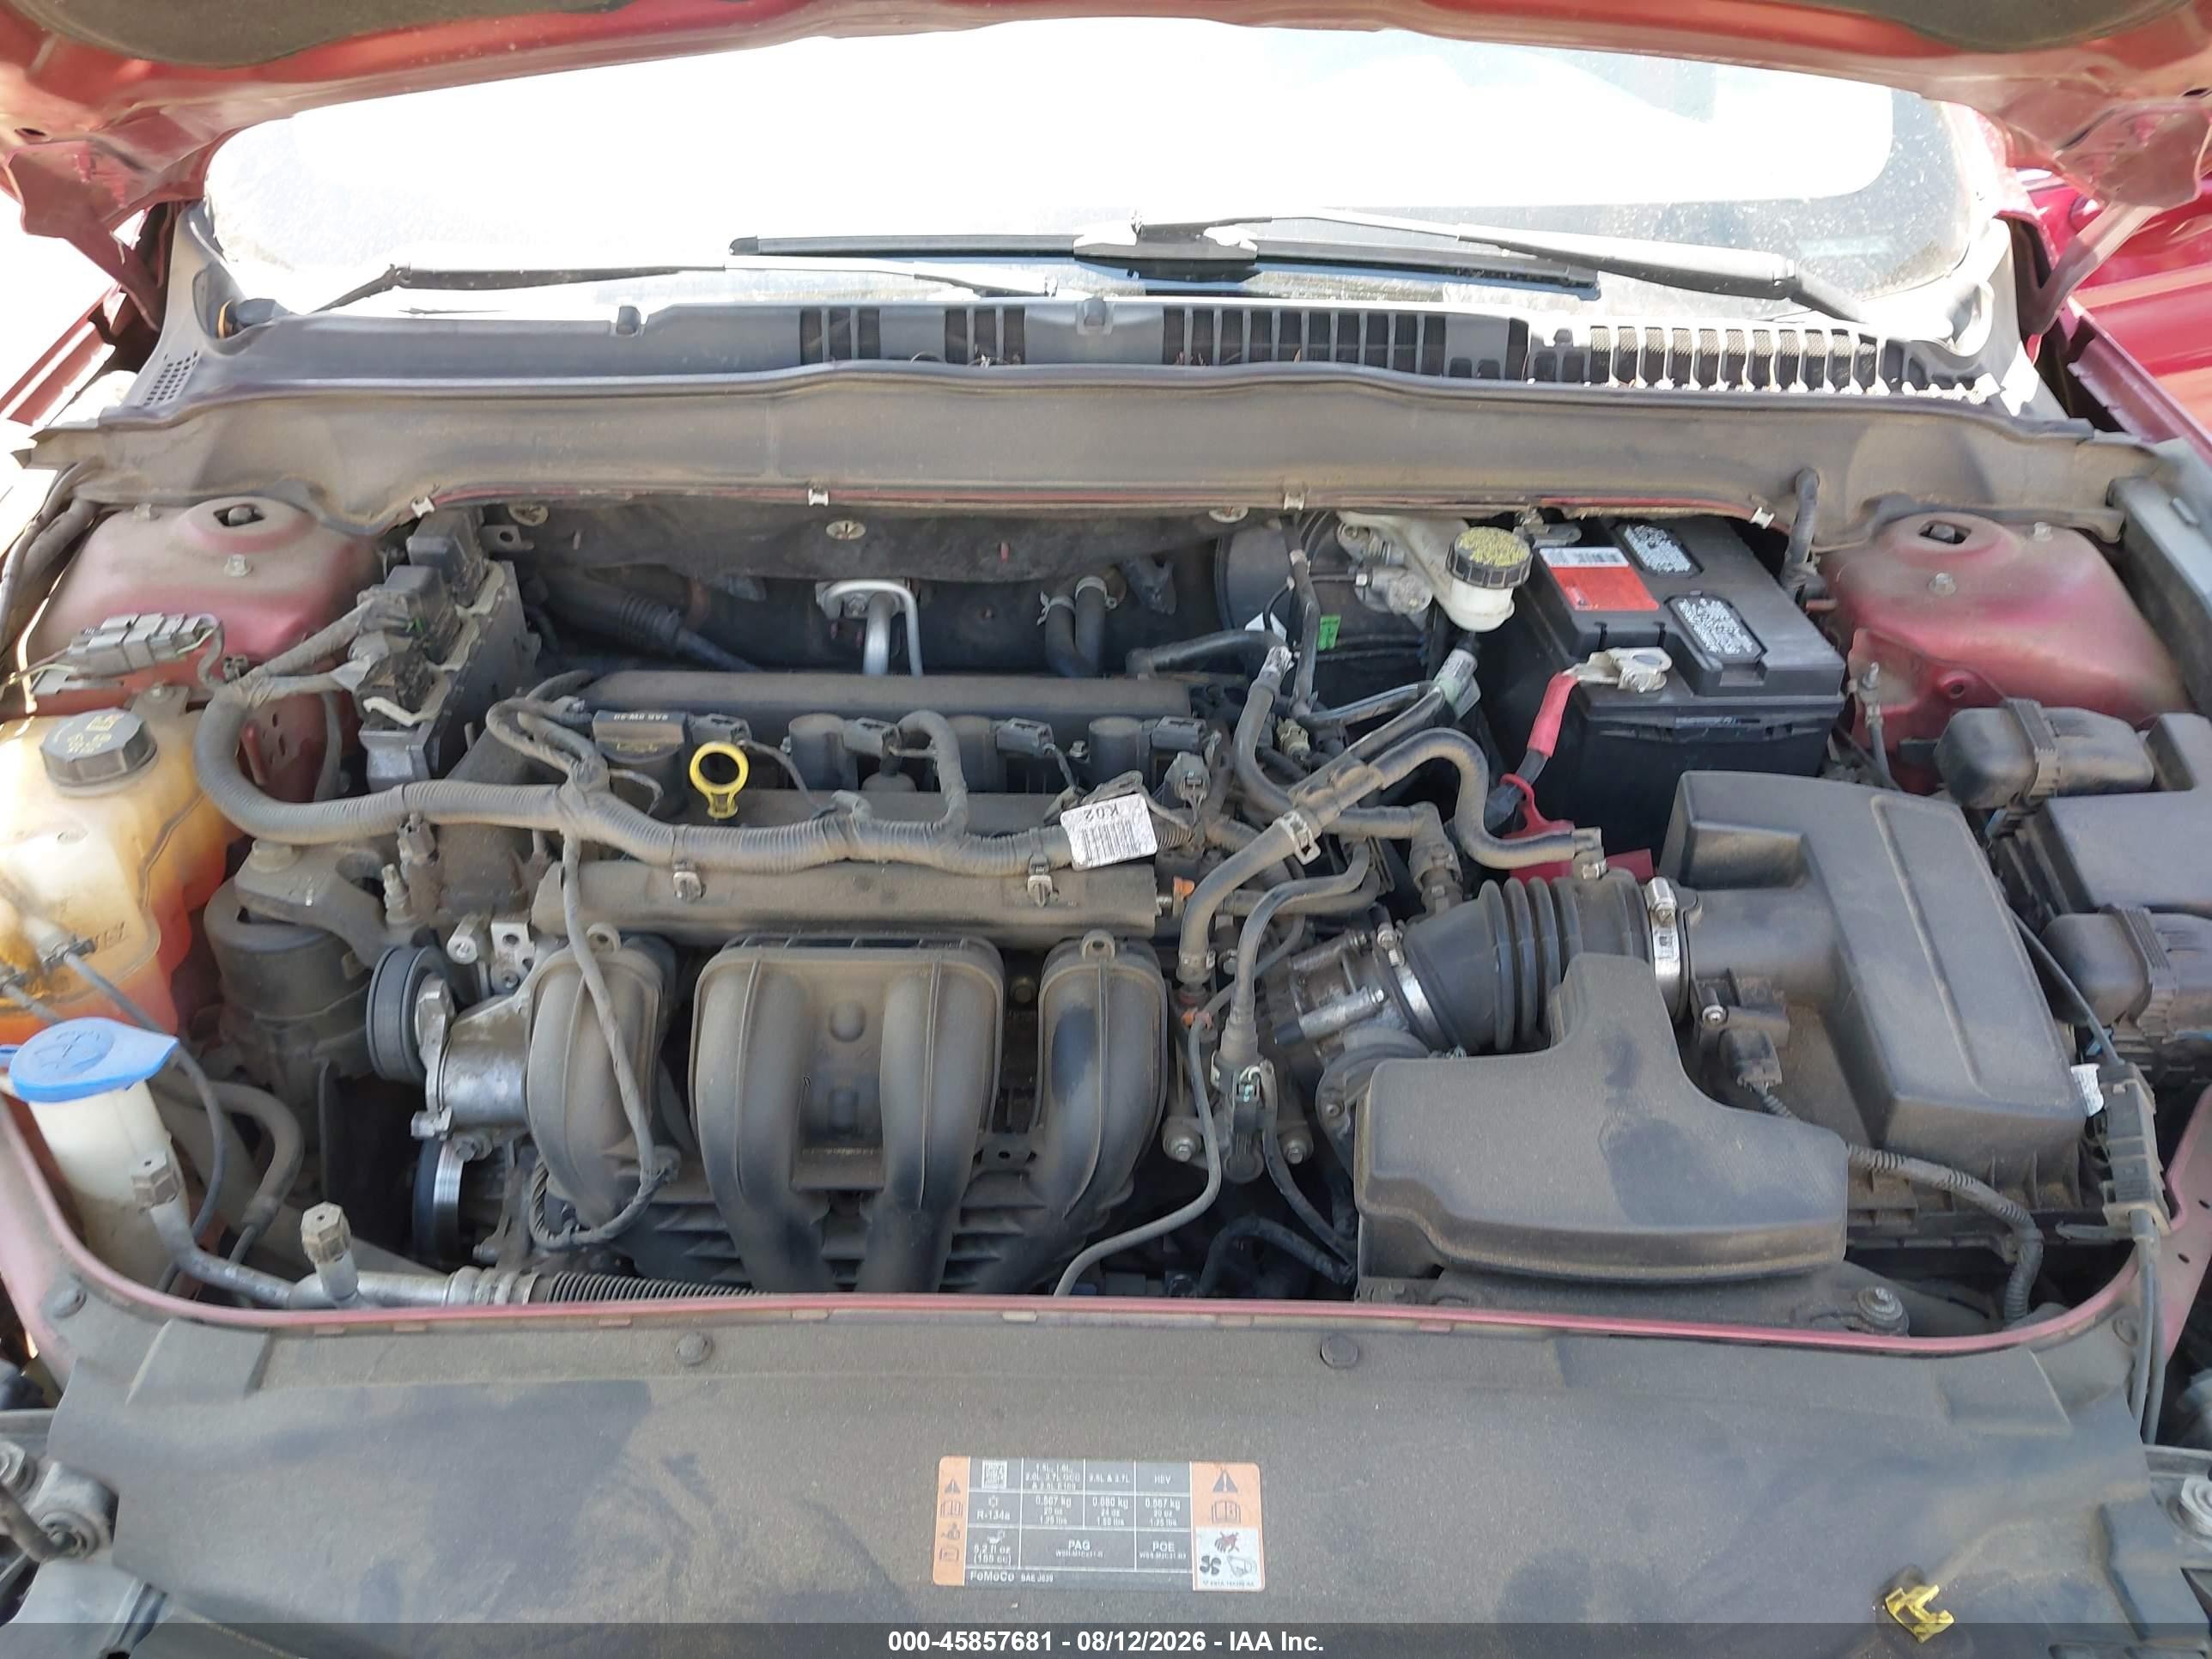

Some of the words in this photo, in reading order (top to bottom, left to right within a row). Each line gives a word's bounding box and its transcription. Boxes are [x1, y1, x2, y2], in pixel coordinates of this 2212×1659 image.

[1060, 1495, 1072, 1508] kg
[1118, 1496, 1129, 1509] kg
[1170, 1498, 1182, 1511] kg
[976, 1509, 1011, 1520] R-134a
[1067, 1539, 1091, 1551] PAG
[1152, 1540, 1176, 1552] POE
[969, 1571, 1015, 1582] FoMoCo
[1020, 1572, 1036, 1582] SAE
